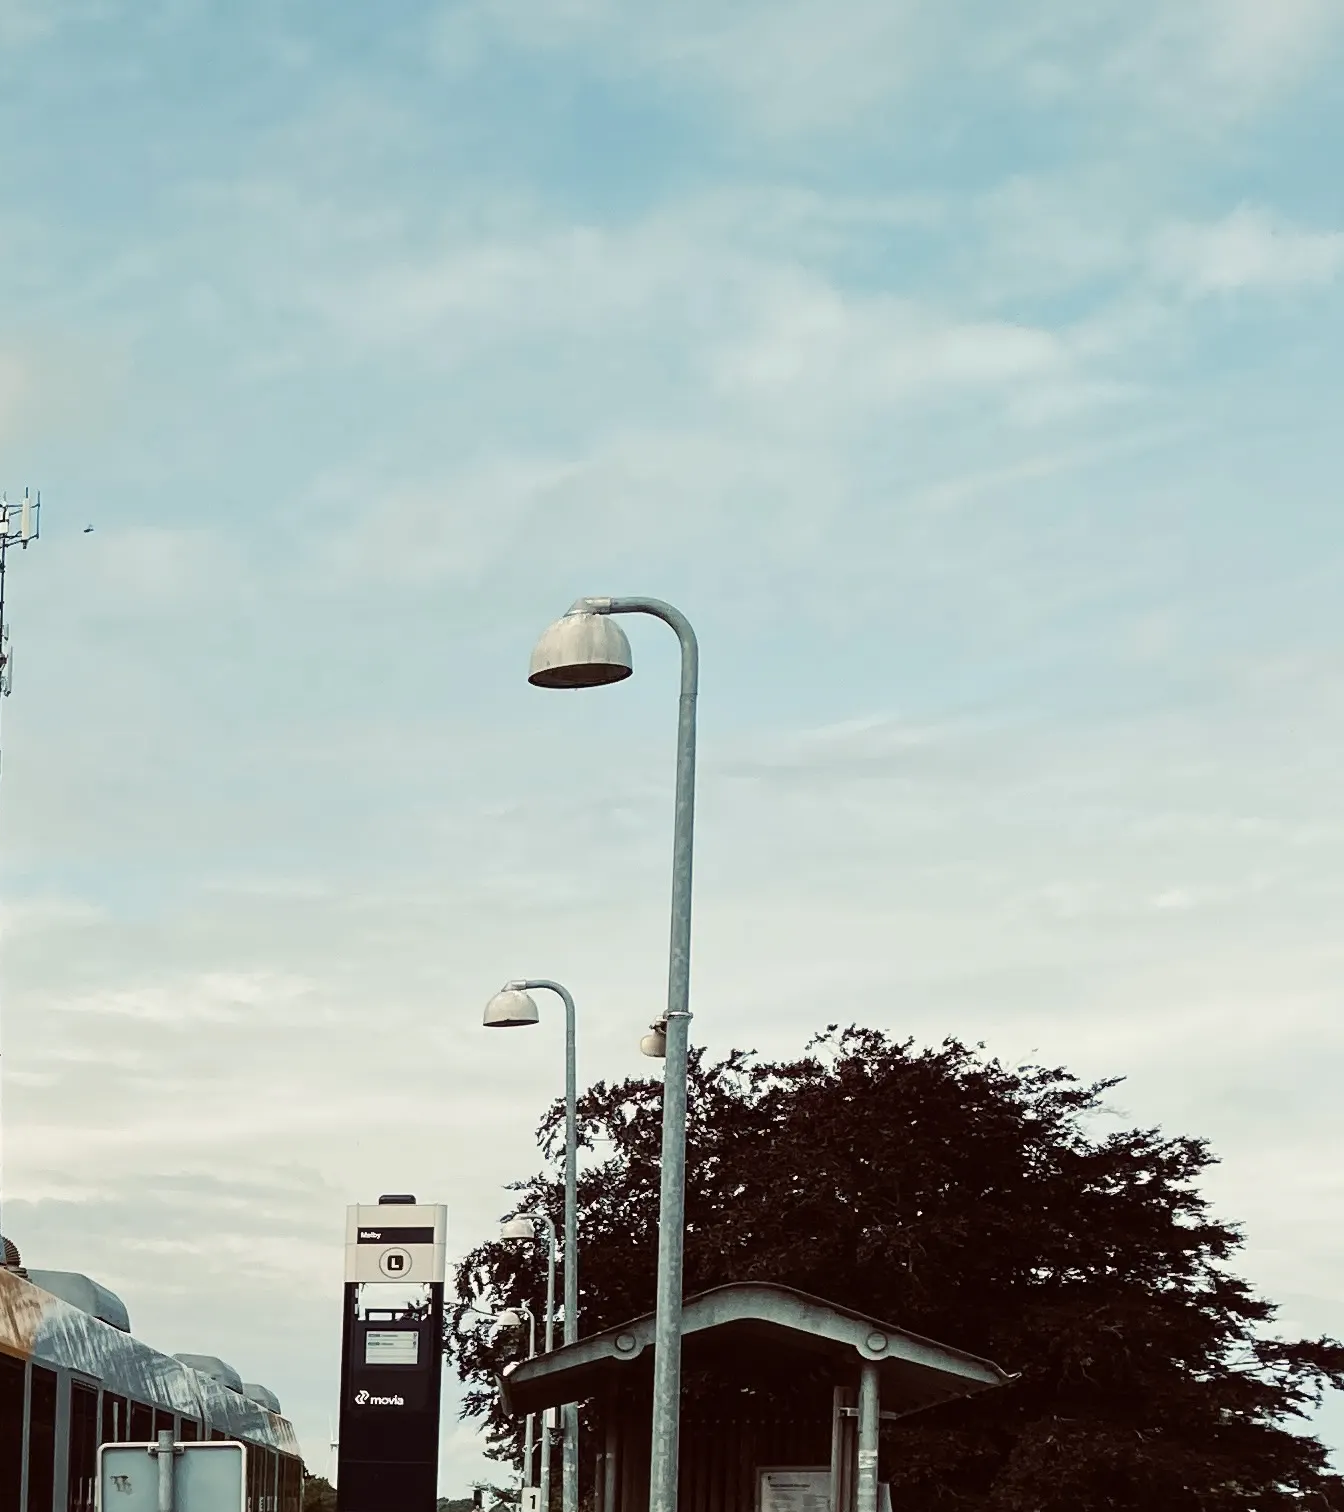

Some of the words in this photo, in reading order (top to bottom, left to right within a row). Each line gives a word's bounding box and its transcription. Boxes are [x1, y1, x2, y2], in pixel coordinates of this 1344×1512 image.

[360, 1231, 382, 1240] Melby
[370, 1394, 405, 1406] movia
[529, 1494, 536, 1510] 1
